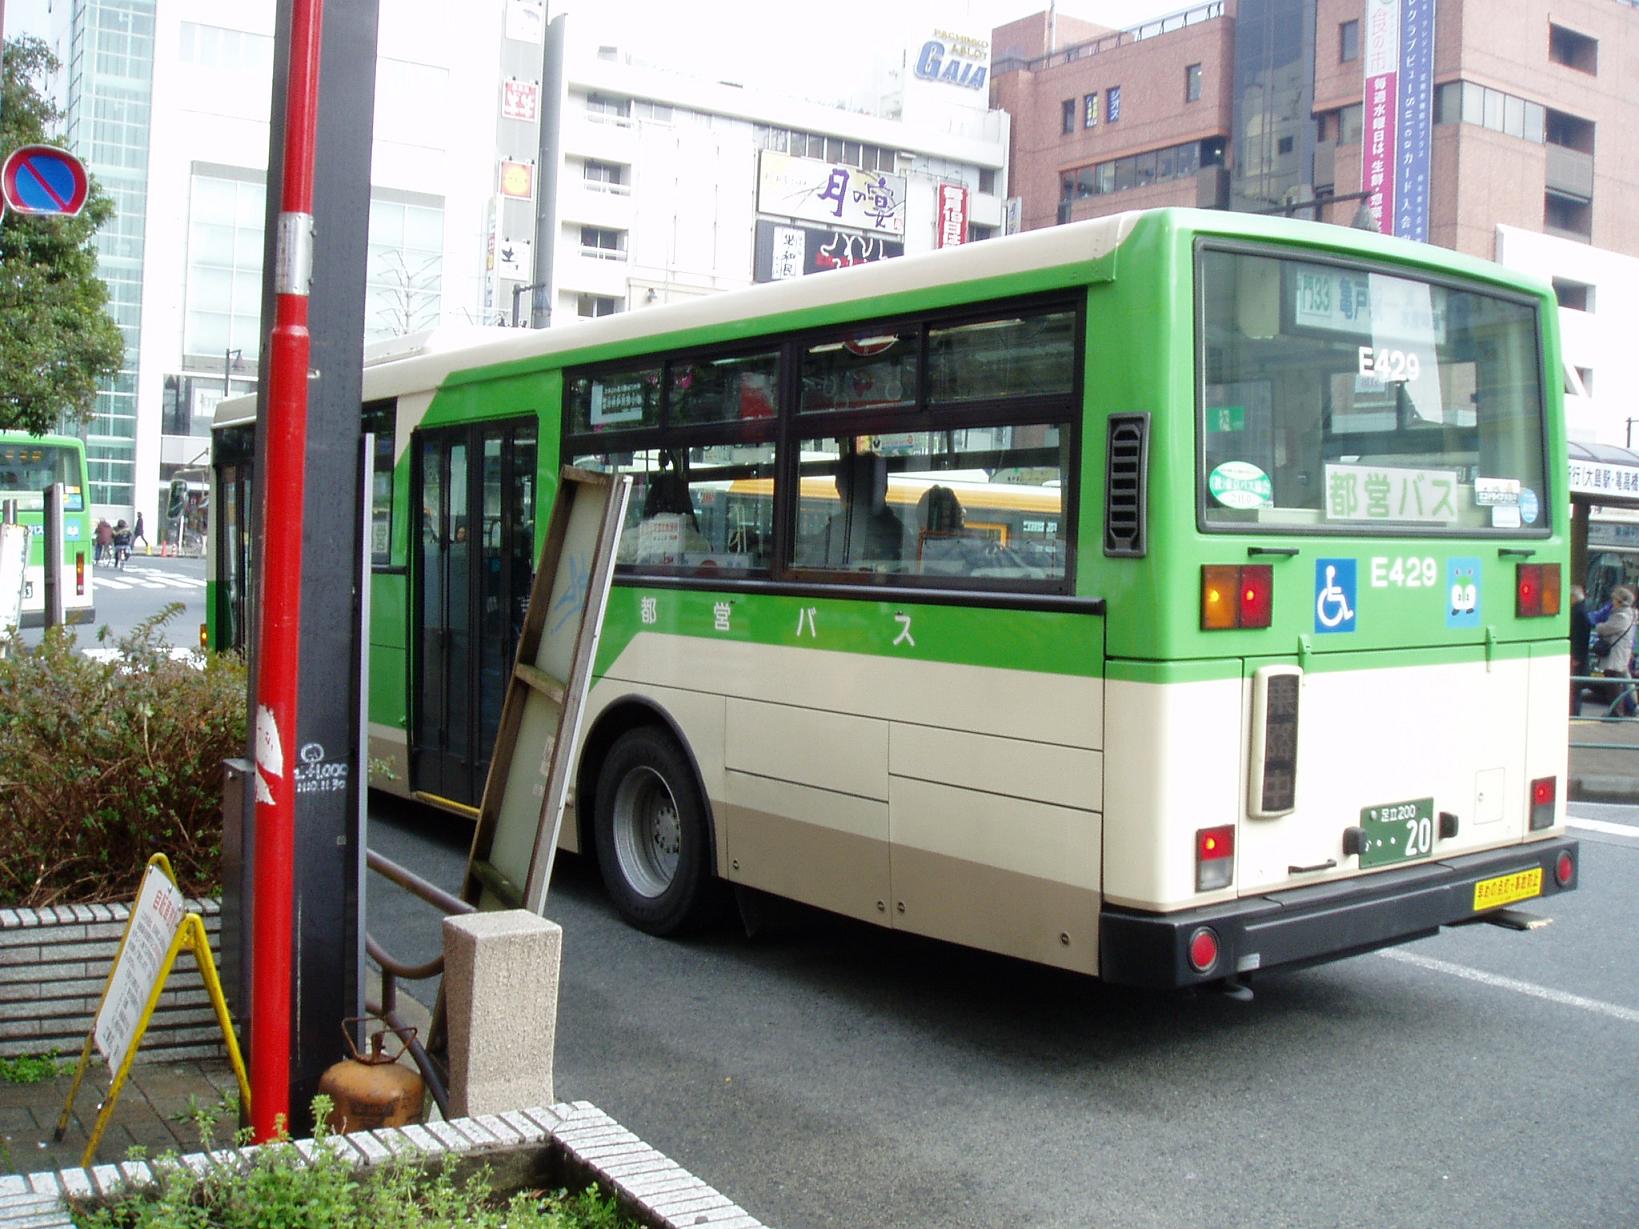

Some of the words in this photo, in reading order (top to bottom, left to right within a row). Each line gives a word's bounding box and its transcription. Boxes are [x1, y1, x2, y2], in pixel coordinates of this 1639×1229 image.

[914, 40, 988, 90] GAIA
[817, 168, 895, 229] 月の宴
[1358, 346, 1420, 382] E429
[1330, 471, 1455, 519] 都営バス
[1370, 556, 1437, 588] E429
